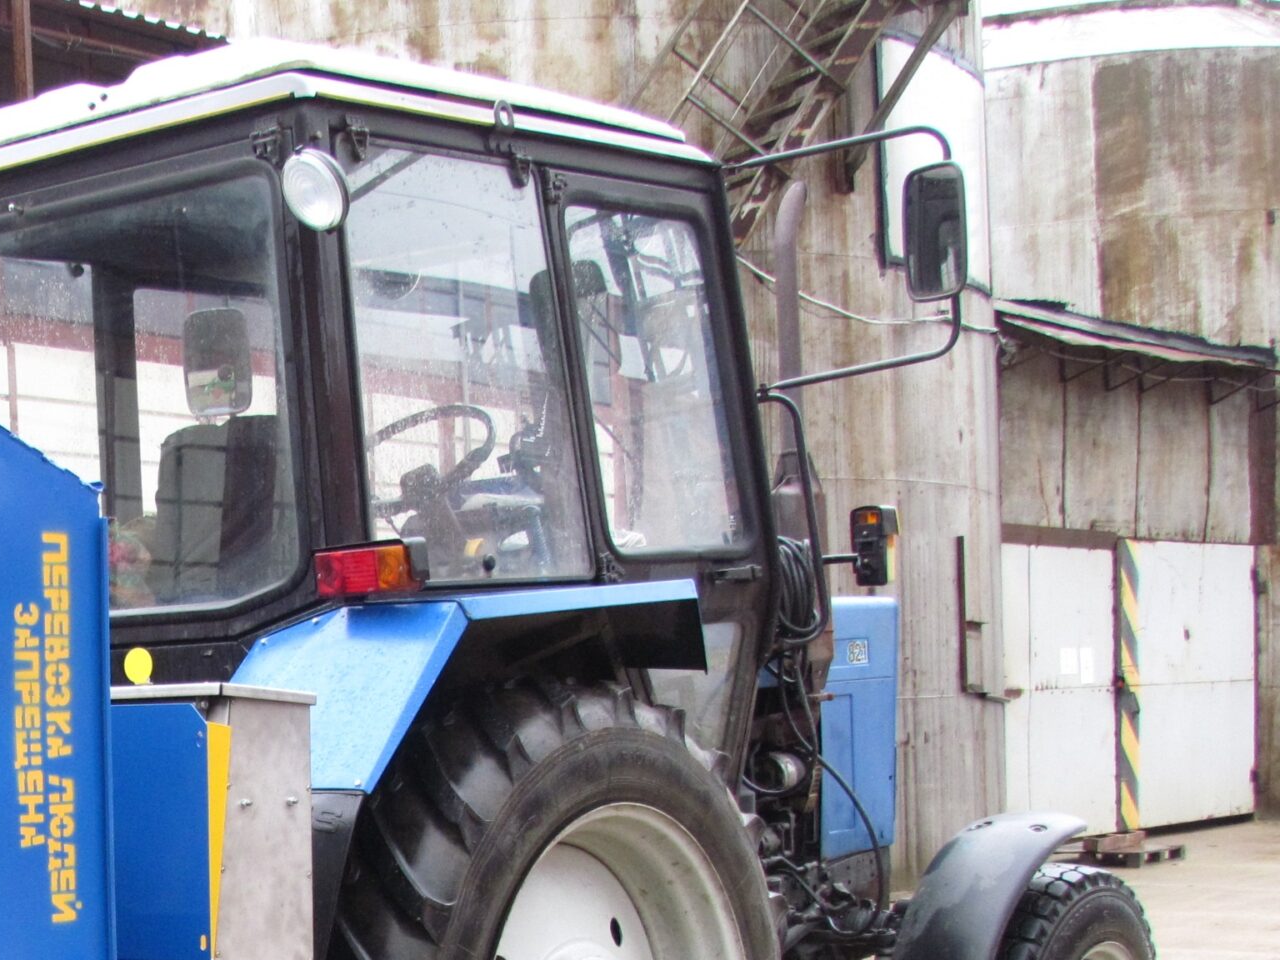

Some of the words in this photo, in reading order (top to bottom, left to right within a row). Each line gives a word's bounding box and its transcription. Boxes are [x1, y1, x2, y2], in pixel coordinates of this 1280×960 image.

[14, 602, 45, 848] ЗАПРЕЩЕНА
[40, 531, 73, 758] ПЕРЕВОЗКА
[48, 774, 82, 924] ЛЮДЕЙ
